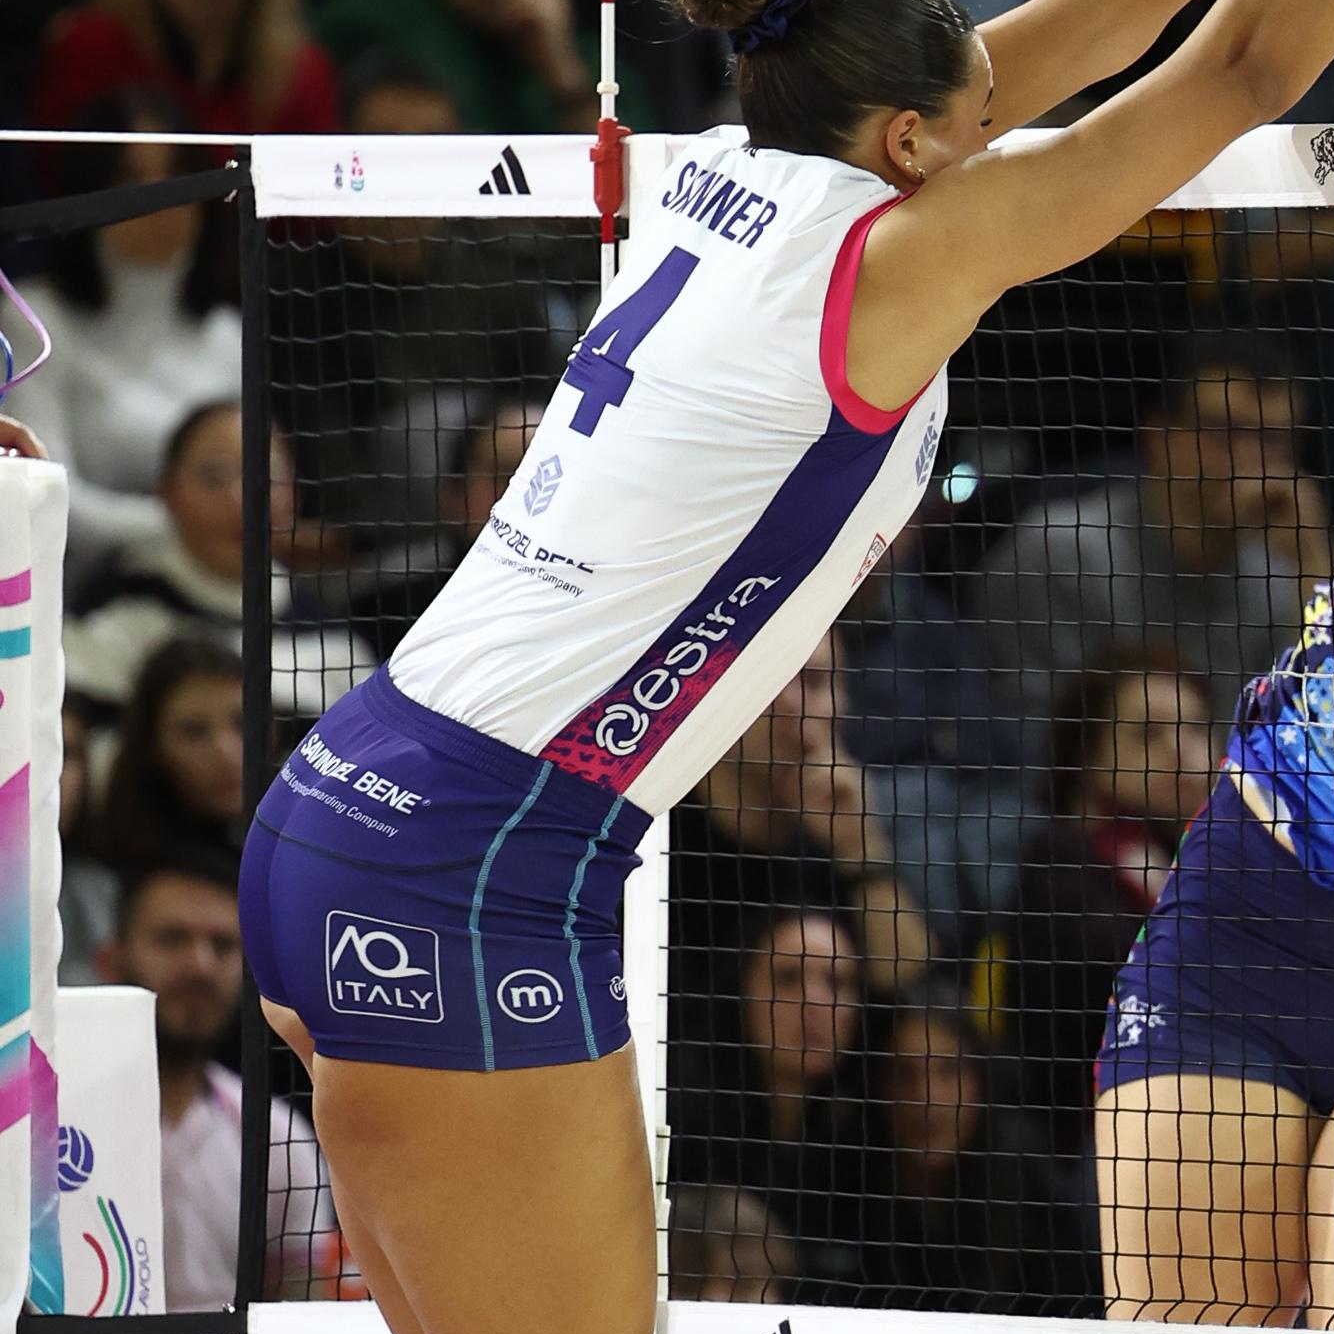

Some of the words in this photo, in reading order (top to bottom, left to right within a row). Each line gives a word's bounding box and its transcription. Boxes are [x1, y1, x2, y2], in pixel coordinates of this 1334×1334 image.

[563, 245, 701, 438] 4
[353, 771, 423, 815] BENE
[347, 806, 399, 838] Company
[336, 980, 434, 1010] ITALY
